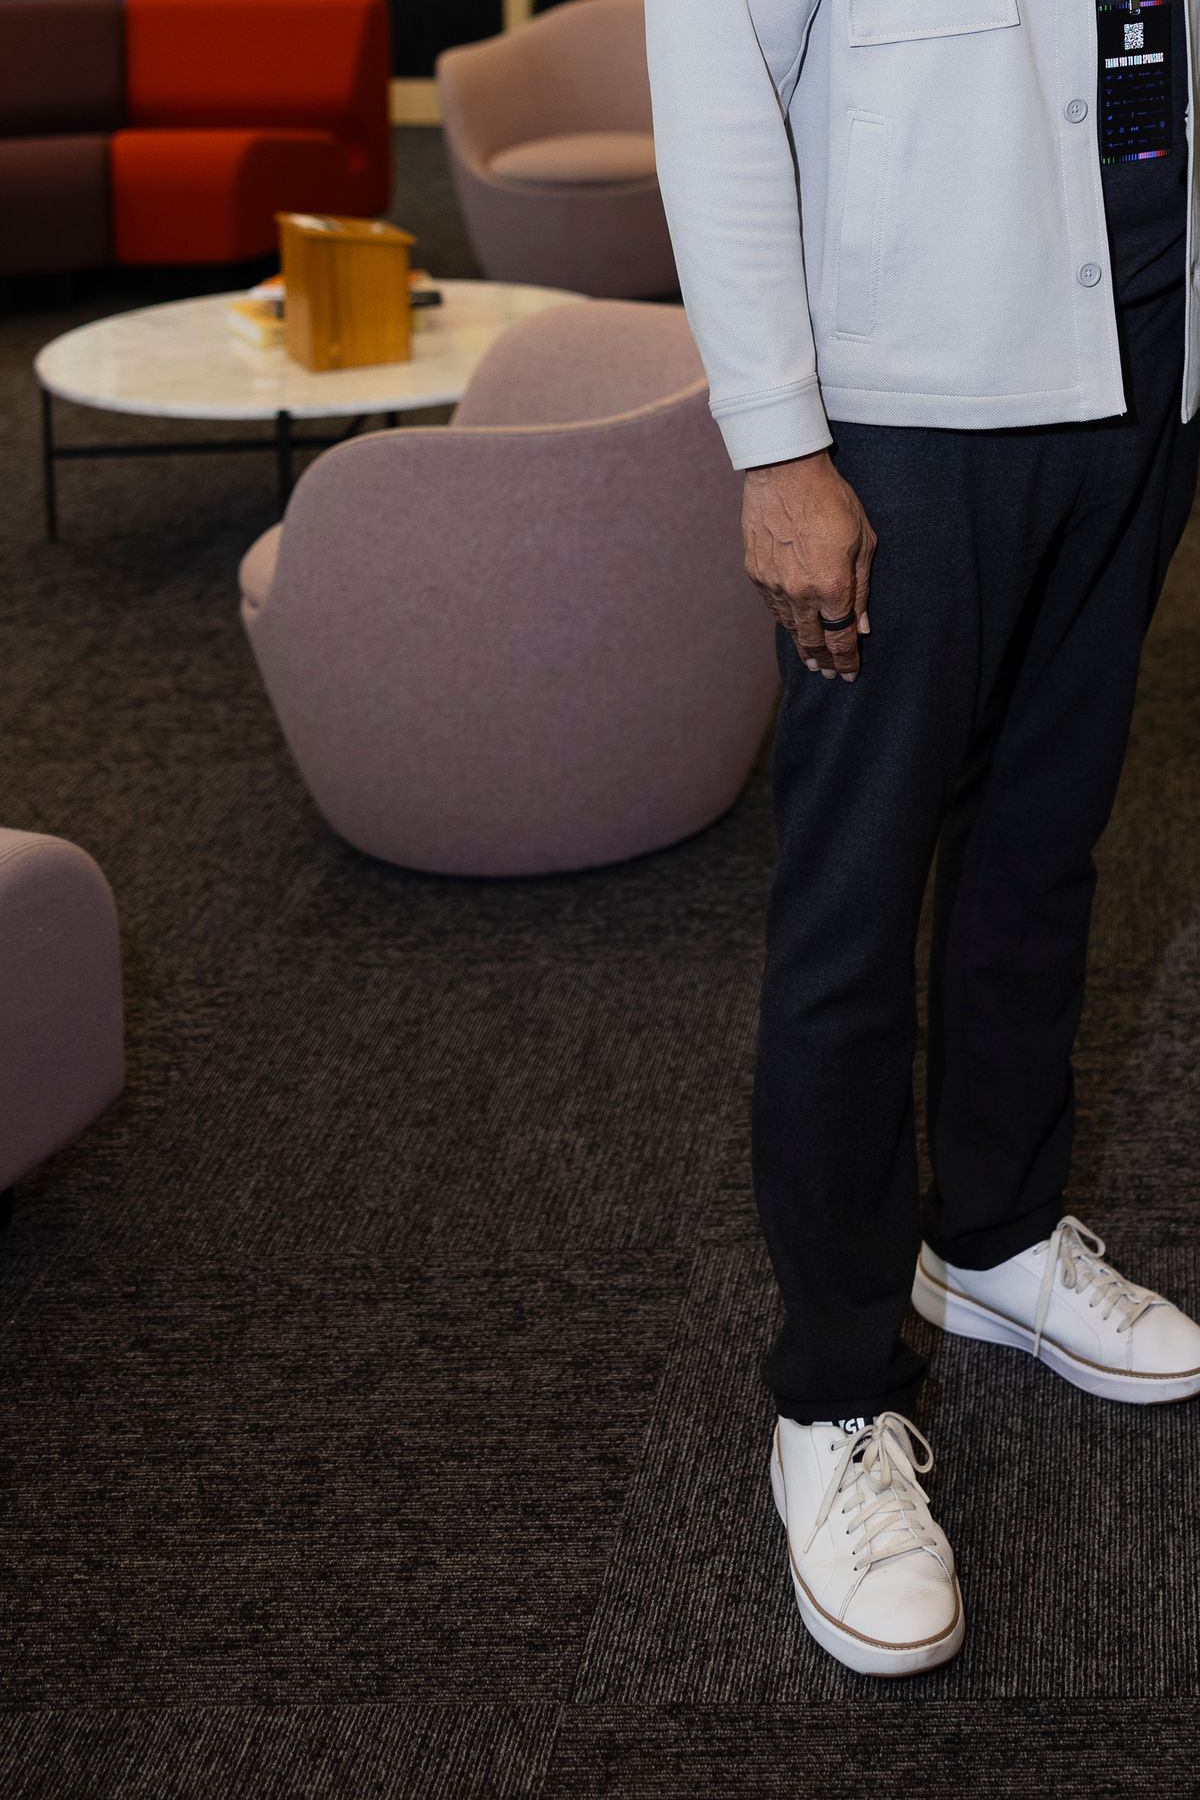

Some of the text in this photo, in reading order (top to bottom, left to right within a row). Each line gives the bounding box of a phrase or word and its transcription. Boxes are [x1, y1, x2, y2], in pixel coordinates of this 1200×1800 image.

[1105, 57, 1119, 68] THANK
[1128, 55, 1133, 66] TO
[1134, 54, 1142, 65] OUR
[1143, 52, 1163, 64] SPONSORS
